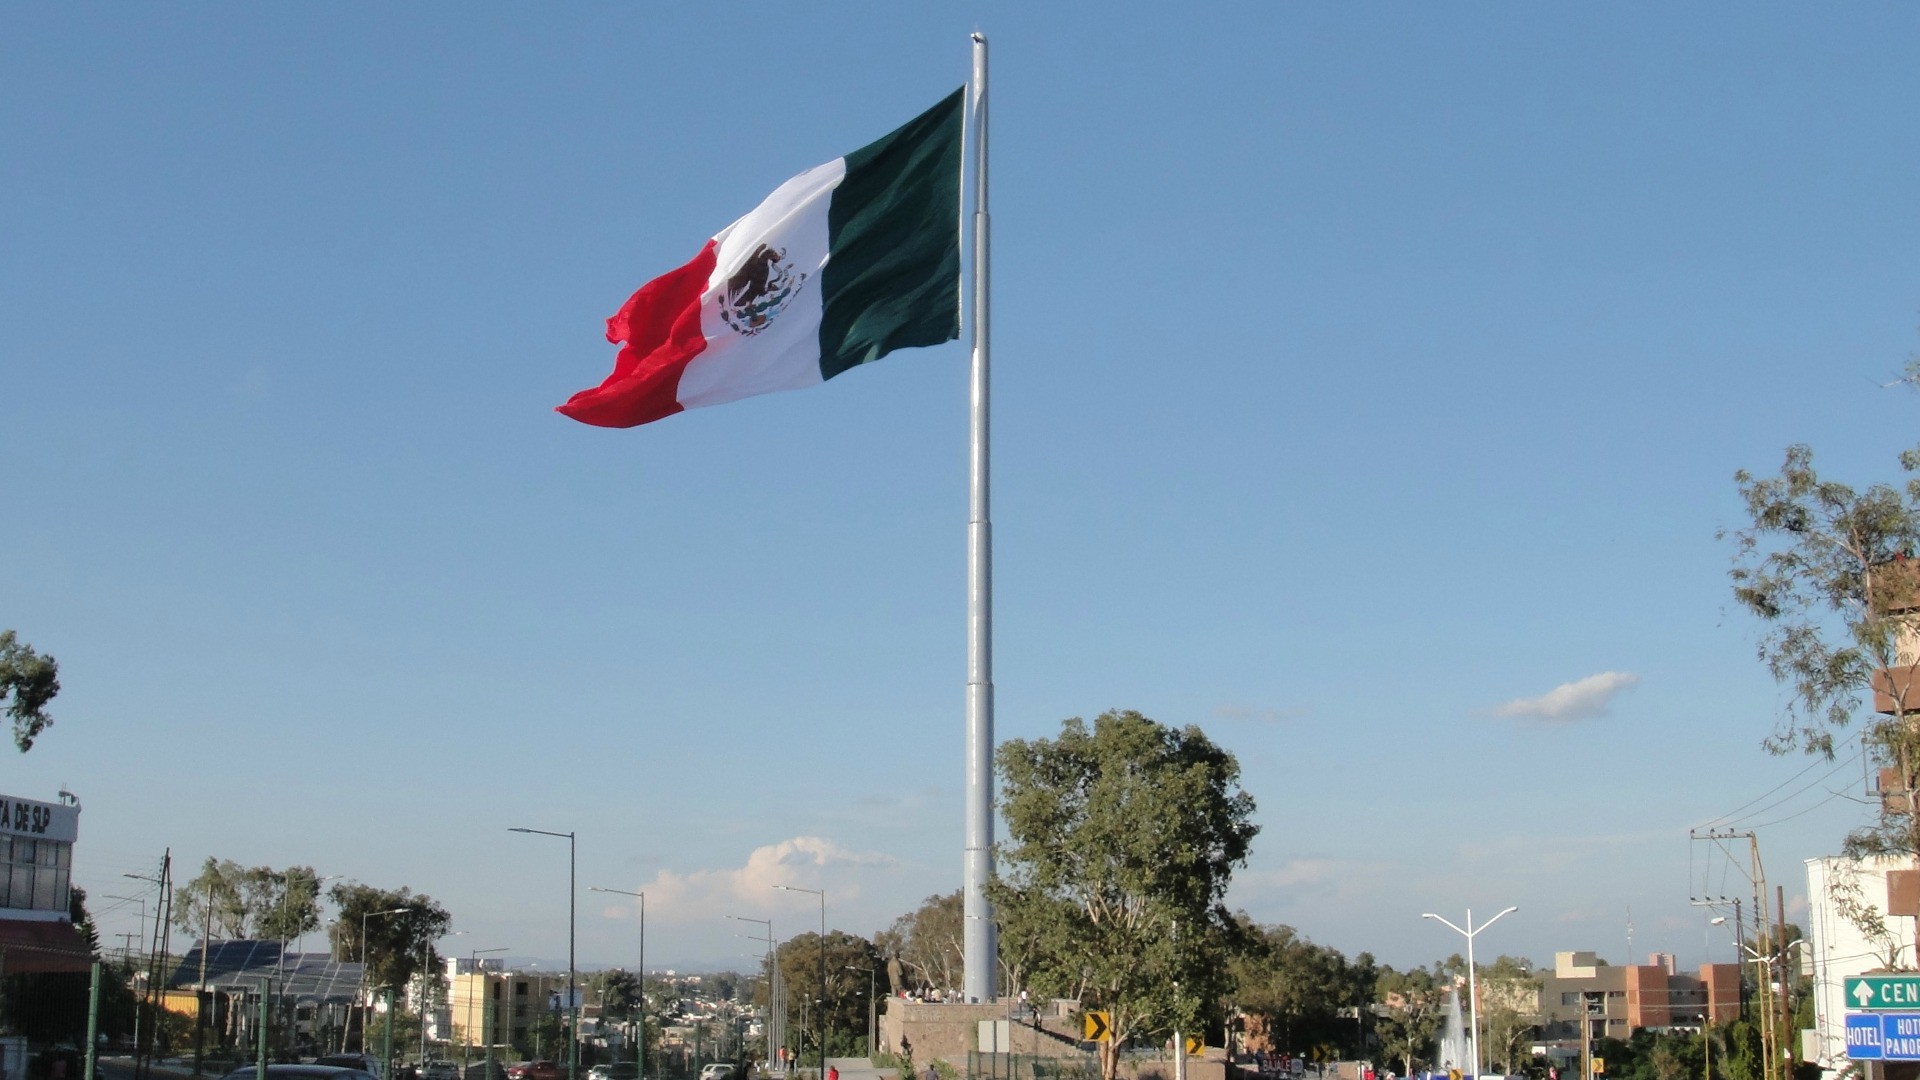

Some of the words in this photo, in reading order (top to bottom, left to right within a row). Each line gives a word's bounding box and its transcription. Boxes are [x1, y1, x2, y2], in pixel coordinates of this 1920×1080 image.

[14, 803, 29, 831] DE
[31, 806, 50, 834] SLP
[1881, 983, 1920, 1002] CEN
[1897, 1018, 1920, 1035] HOT
[1846, 1027, 1881, 1046] HOTEL
